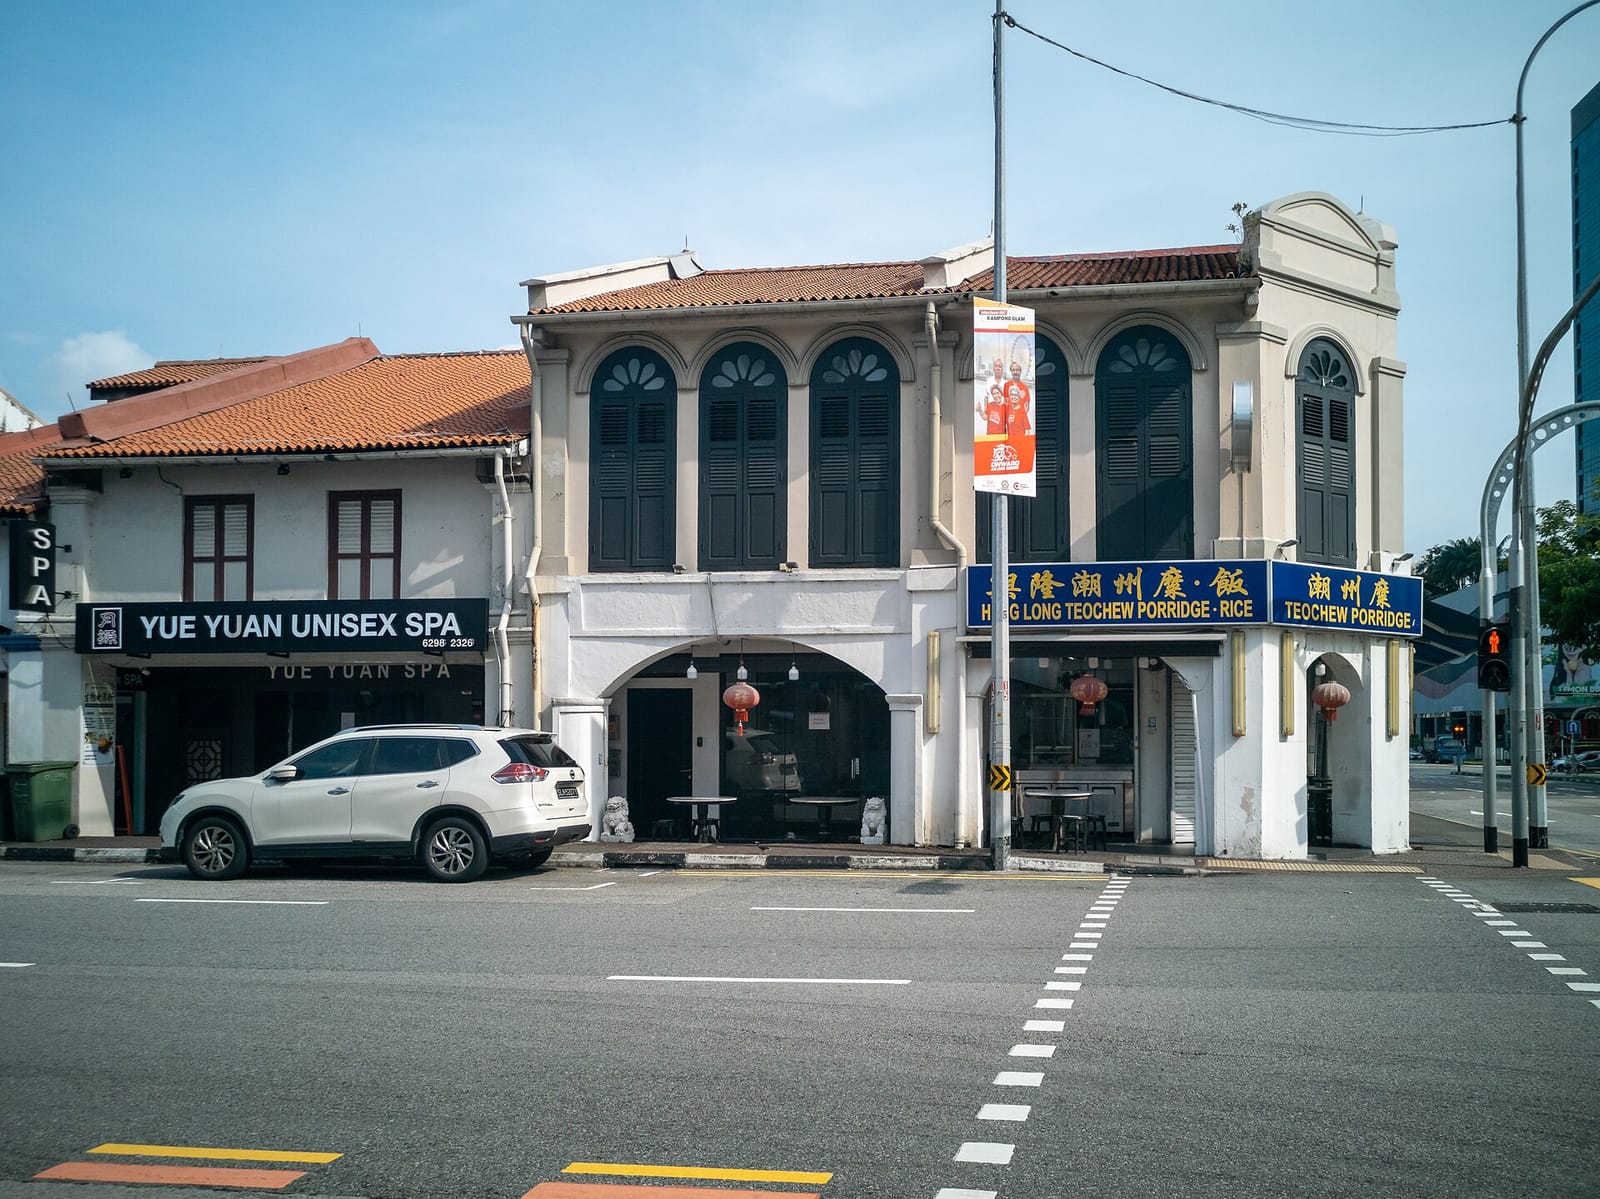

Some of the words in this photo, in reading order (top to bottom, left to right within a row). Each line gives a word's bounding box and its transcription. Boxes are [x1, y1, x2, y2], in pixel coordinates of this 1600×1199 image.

[31, 528, 51, 606] SPA
[981, 602, 1020, 621] HG
[1023, 602, 1062, 621] LONG
[1065, 601, 1134, 620] TEOCHEW
[1137, 600, 1210, 619] PORRIDGE
[1220, 599, 1253, 618] RICE
[1285, 601, 1348, 623] TEOCHEW
[1351, 607, 1411, 629] PORRIDGE
[140, 615, 196, 639] YUE
[204, 614, 282, 638] YUAN
[291, 613, 398, 638] UNISEX
[405, 612, 463, 637] SPA
[422, 639, 446, 648] 6298
[450, 639, 474, 648] 2326
[268, 664, 312, 679] YUE
[328, 664, 390, 679] YUAN
[404, 664, 451, 679] SPA
